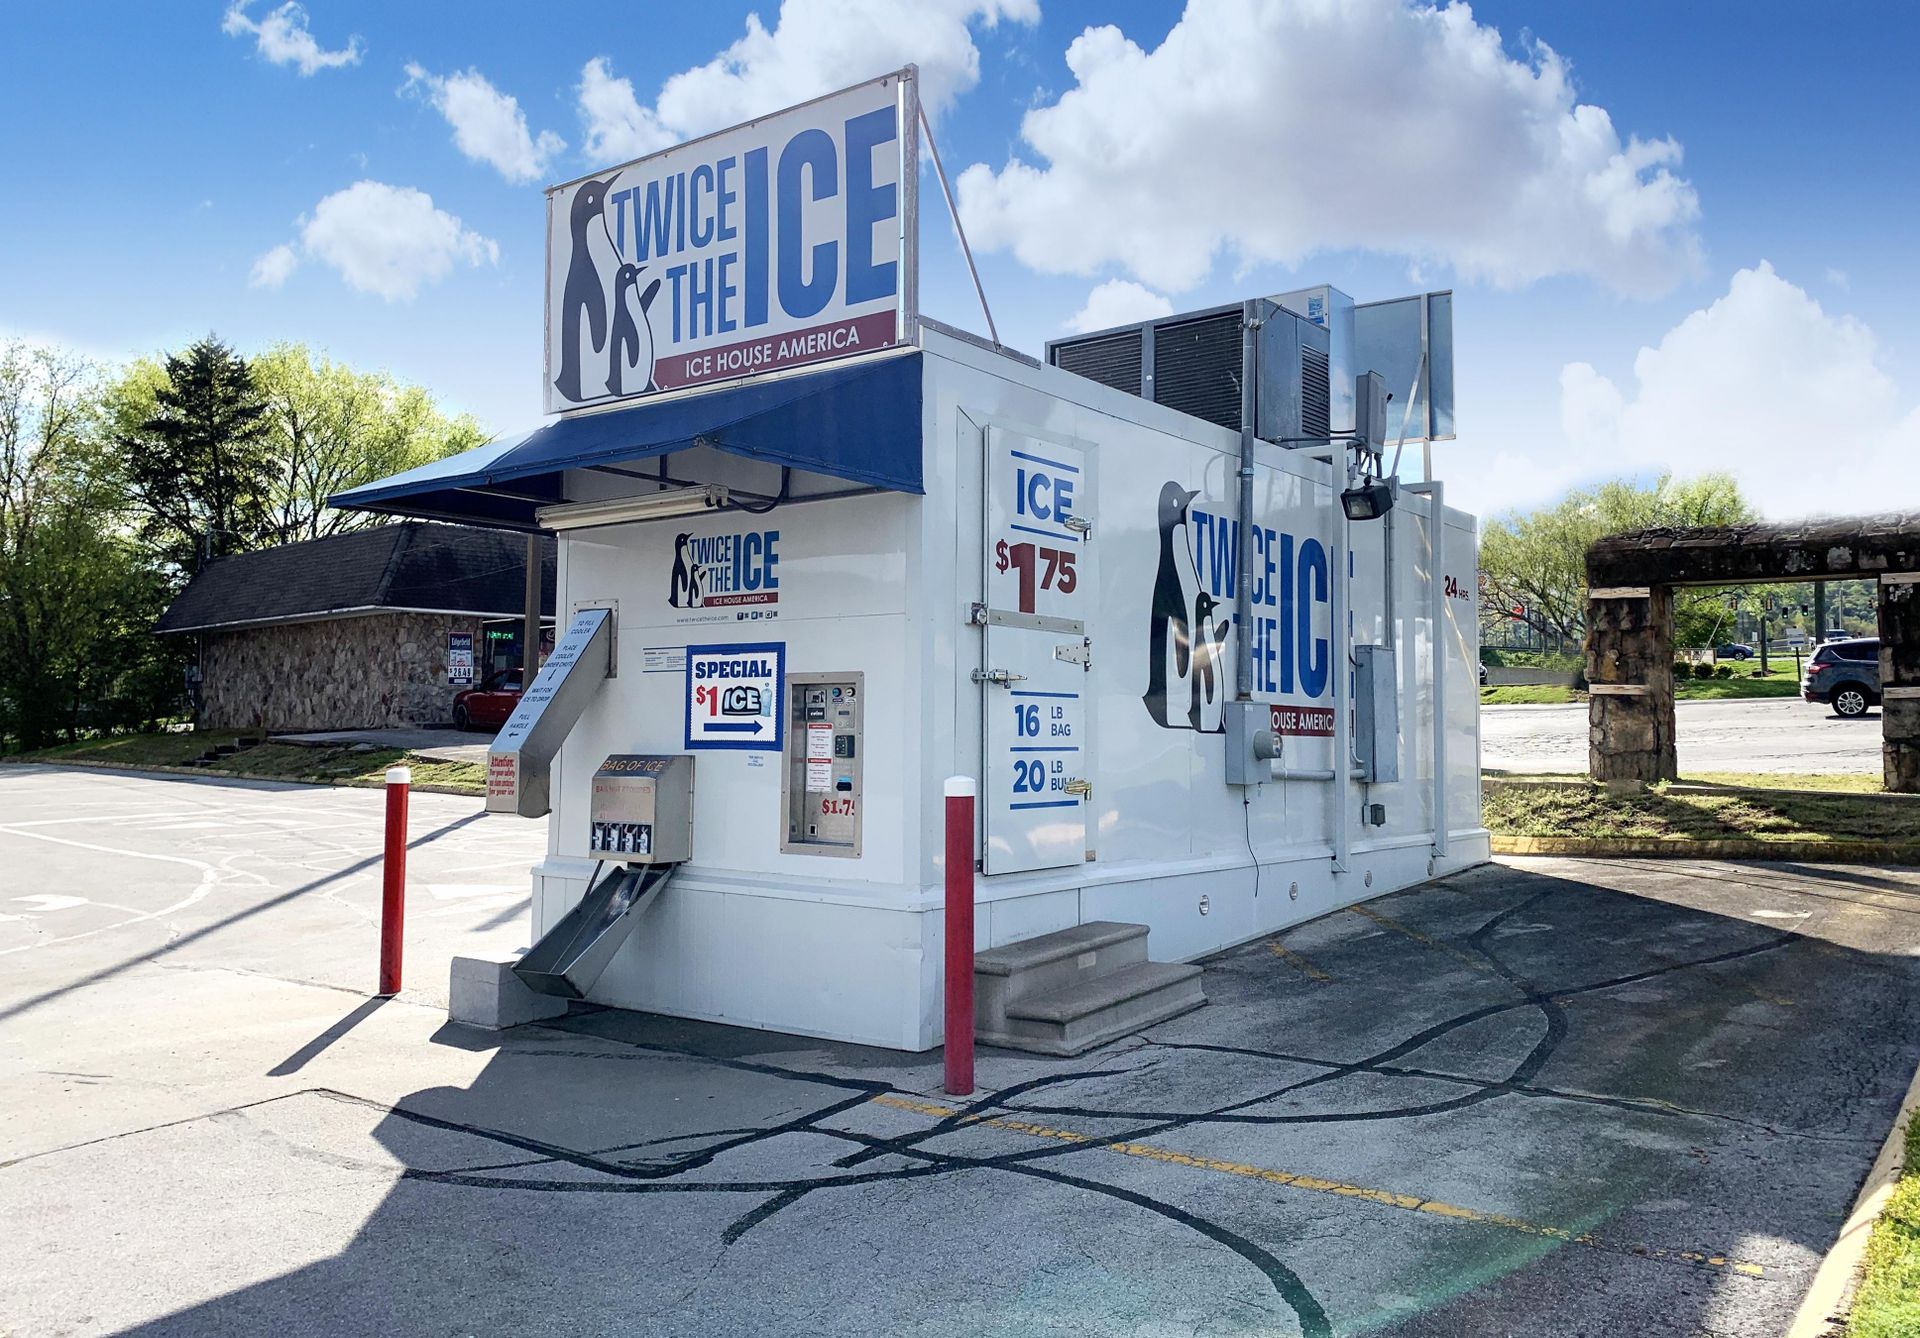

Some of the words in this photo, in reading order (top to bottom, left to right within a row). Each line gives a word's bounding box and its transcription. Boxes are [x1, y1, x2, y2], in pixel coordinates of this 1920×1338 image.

[611, 156, 737, 263] TWICE
[743, 104, 897, 328] ICE
[666, 252, 737, 343] THE
[685, 355, 712, 378] ICE
[717, 343, 772, 372] HOUSE
[777, 325, 860, 361] AMERICA
[1016, 468, 1074, 524] ICE
[690, 535, 732, 564] TWICE
[732, 530, 780, 592] ICE
[1191, 510, 1277, 607] TWCE
[708, 566, 731, 593] THE
[1444, 575, 1457, 598] 24
[713, 597, 722, 605] ICE
[723, 596, 742, 605] HOUSE
[742, 594, 768, 603] AMERICA
[1232, 612, 1277, 693] HE
[695, 660, 772, 679] SPECIAL
[696, 685, 718, 716] $1
[723, 687, 761, 712] ICE
[1014, 704, 1040, 737] 16
[1051, 706, 1063, 719] LB
[1051, 723, 1071, 736] BAG
[600, 760, 627, 771] BAG
[626, 760, 645, 771] OF
[643, 760, 666, 771] ICE
[1013, 759, 1045, 793] 20
[1051, 760, 1063, 774] LB
